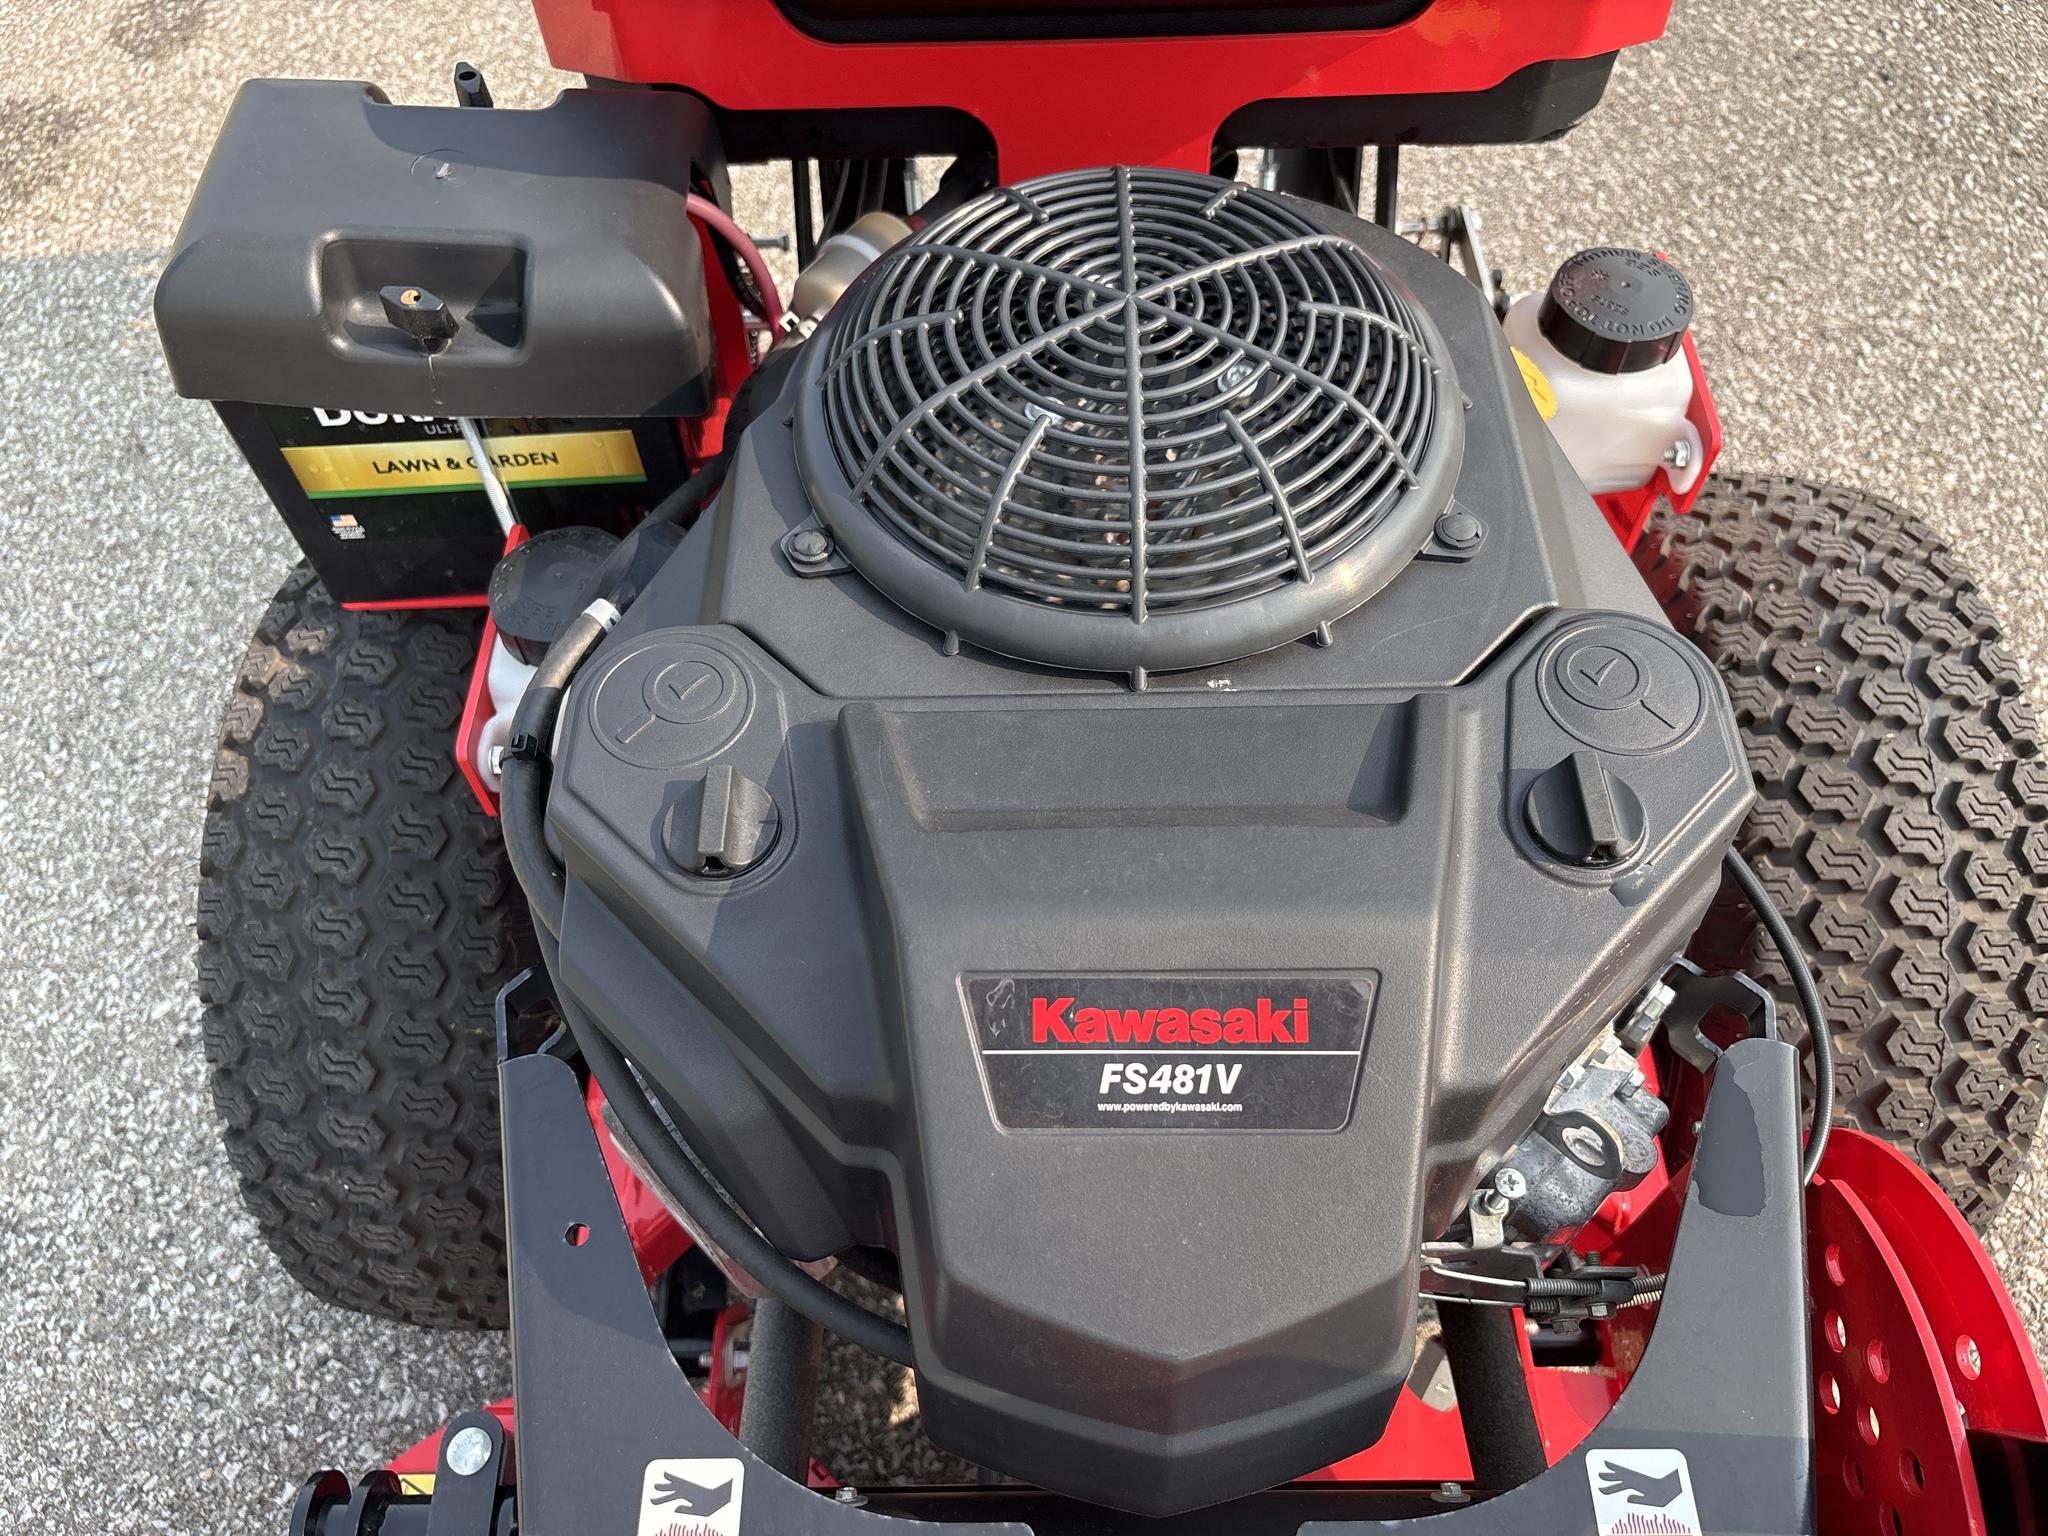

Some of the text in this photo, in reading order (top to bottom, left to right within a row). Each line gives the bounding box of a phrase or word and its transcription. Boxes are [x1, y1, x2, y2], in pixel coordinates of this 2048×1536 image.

[1600, 320, 1645, 336] NOT
[1647, 314, 1675, 333] DO
[371, 457, 440, 475] LAWN
[447, 456, 463, 470] &
[520, 596, 557, 619] SEE
[1031, 997, 1310, 1044] Kawasaki
[1099, 1063, 1243, 1095] FS481V
[1097, 1102, 1243, 1113] www.poweredbykawasaki.com
